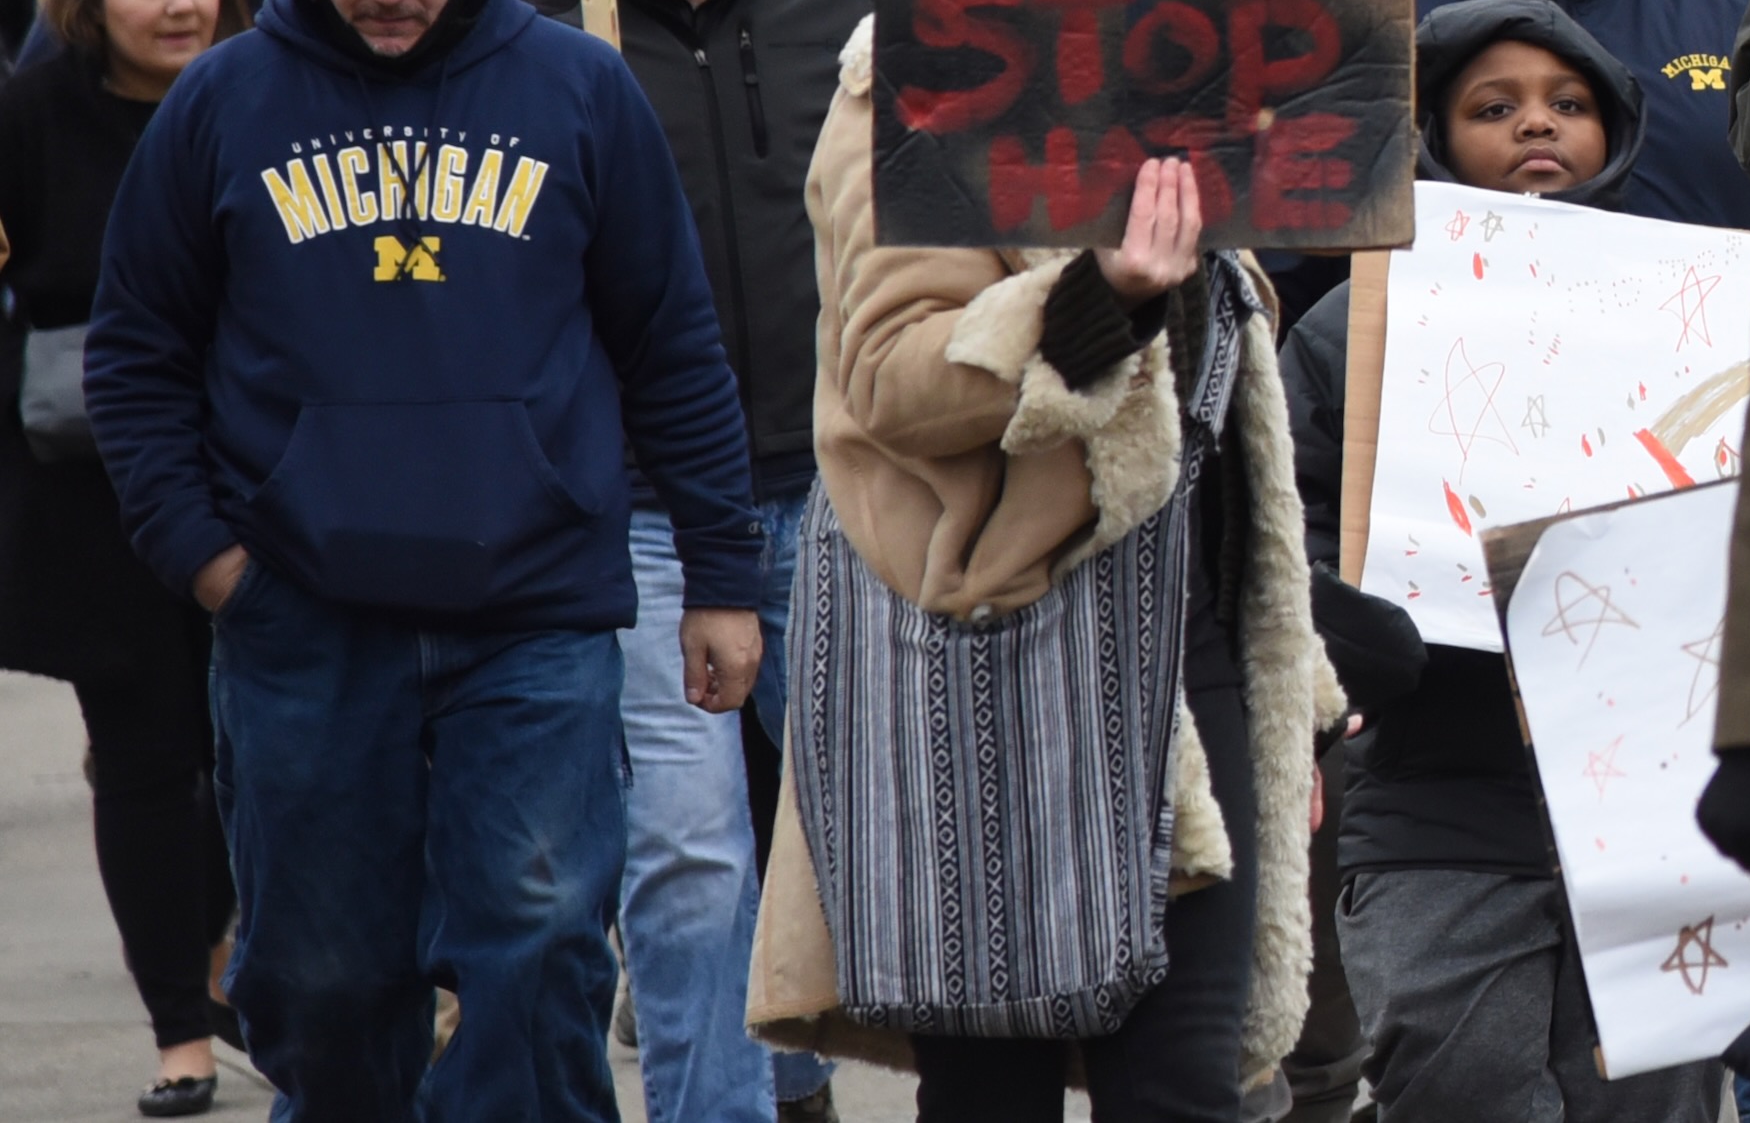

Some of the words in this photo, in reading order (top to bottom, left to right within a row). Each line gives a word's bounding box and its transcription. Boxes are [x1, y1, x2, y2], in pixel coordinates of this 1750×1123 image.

[1661, 54, 1731, 79] MICHIGA
[1688, 68, 1725, 90] M
[291, 126, 466, 154] UNIVERSITY
[490, 133, 520, 149] OF
[260, 140, 549, 244] MICHIGAN
[373, 235, 441, 282] M
